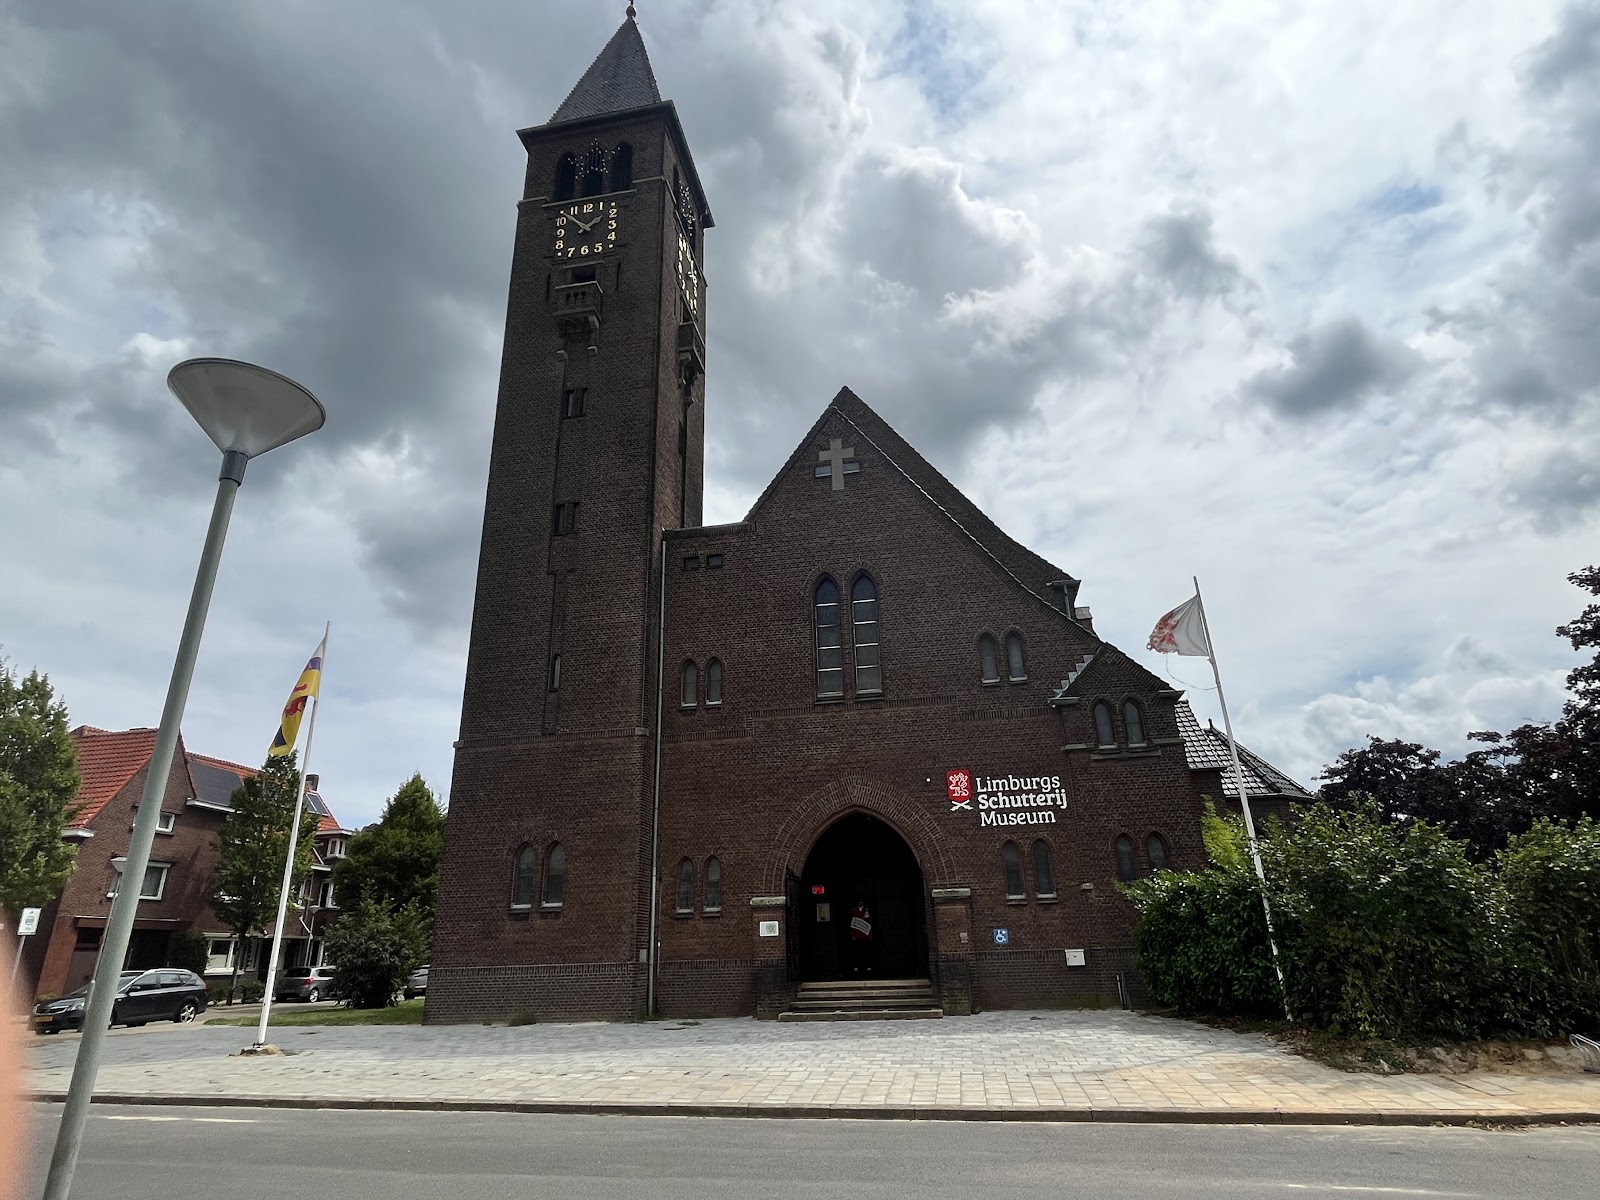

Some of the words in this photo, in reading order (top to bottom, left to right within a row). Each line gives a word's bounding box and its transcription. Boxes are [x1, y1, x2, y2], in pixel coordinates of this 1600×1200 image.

[570, 205, 578, 215] 11
[583, 203, 594, 213] 12
[599, 201, 604, 210] 1
[608, 208, 618, 218] 2
[555, 216, 567, 227] 10
[608, 219, 617, 230] 3
[556, 228, 565, 238] 9
[607, 231, 617, 241] 4
[555, 239, 564, 250] 8
[567, 247, 576, 258] 7
[580, 245, 589, 255] 6
[593, 242, 603, 253] 5
[975, 775, 1060, 792] Limburgs
[978, 789, 1068, 809] Schutterij
[980, 810, 1056, 827] Museum
